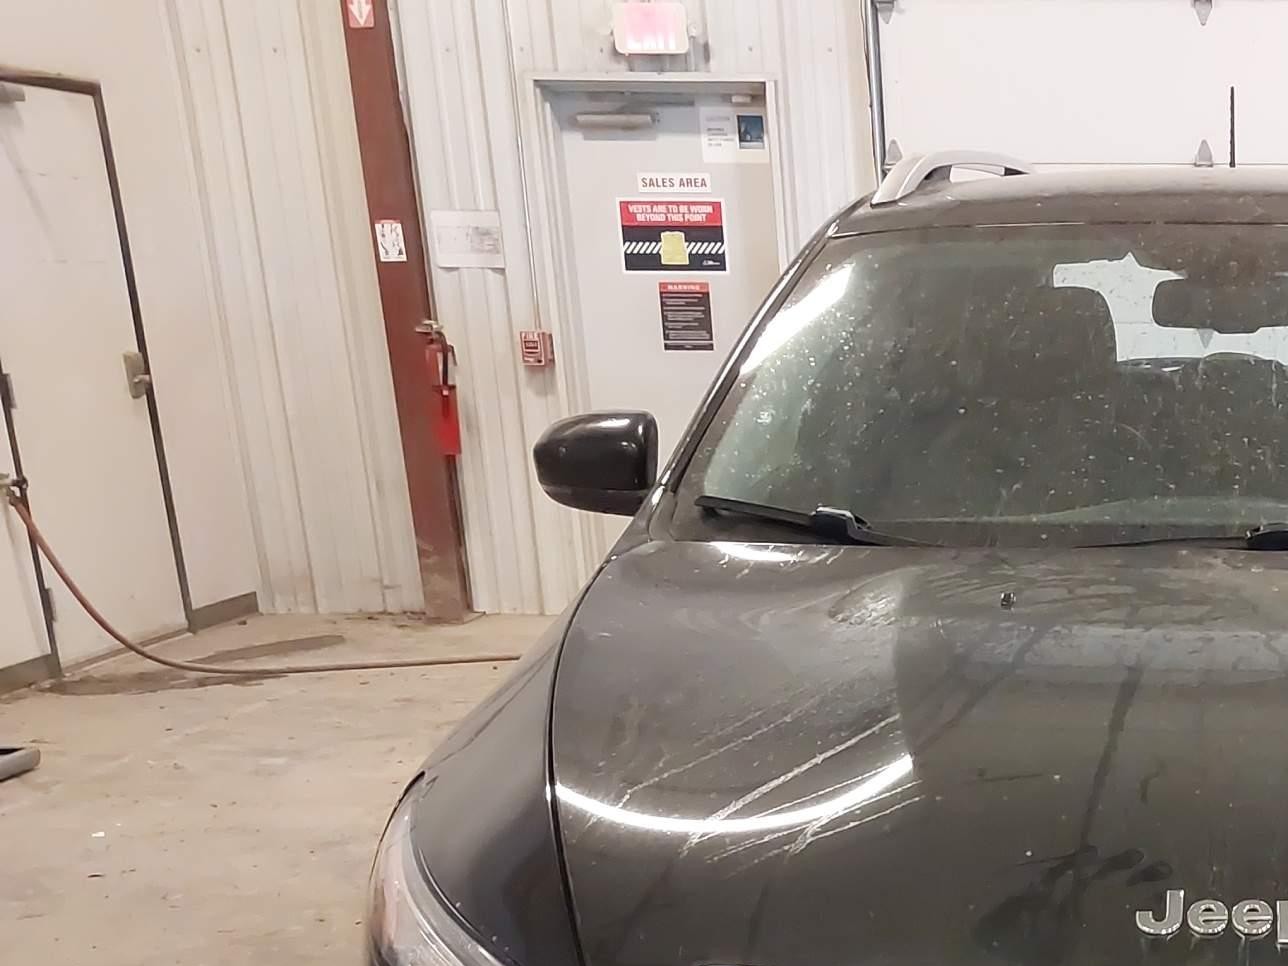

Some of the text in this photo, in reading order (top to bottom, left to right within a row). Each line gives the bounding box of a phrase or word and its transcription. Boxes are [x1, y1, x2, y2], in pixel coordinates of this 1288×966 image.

[641, 177, 707, 188] SALES AREA
[628, 204, 713, 213] VESTS ARE TO BE WORN
[636, 213, 706, 222] BEYOND THIS POINT
